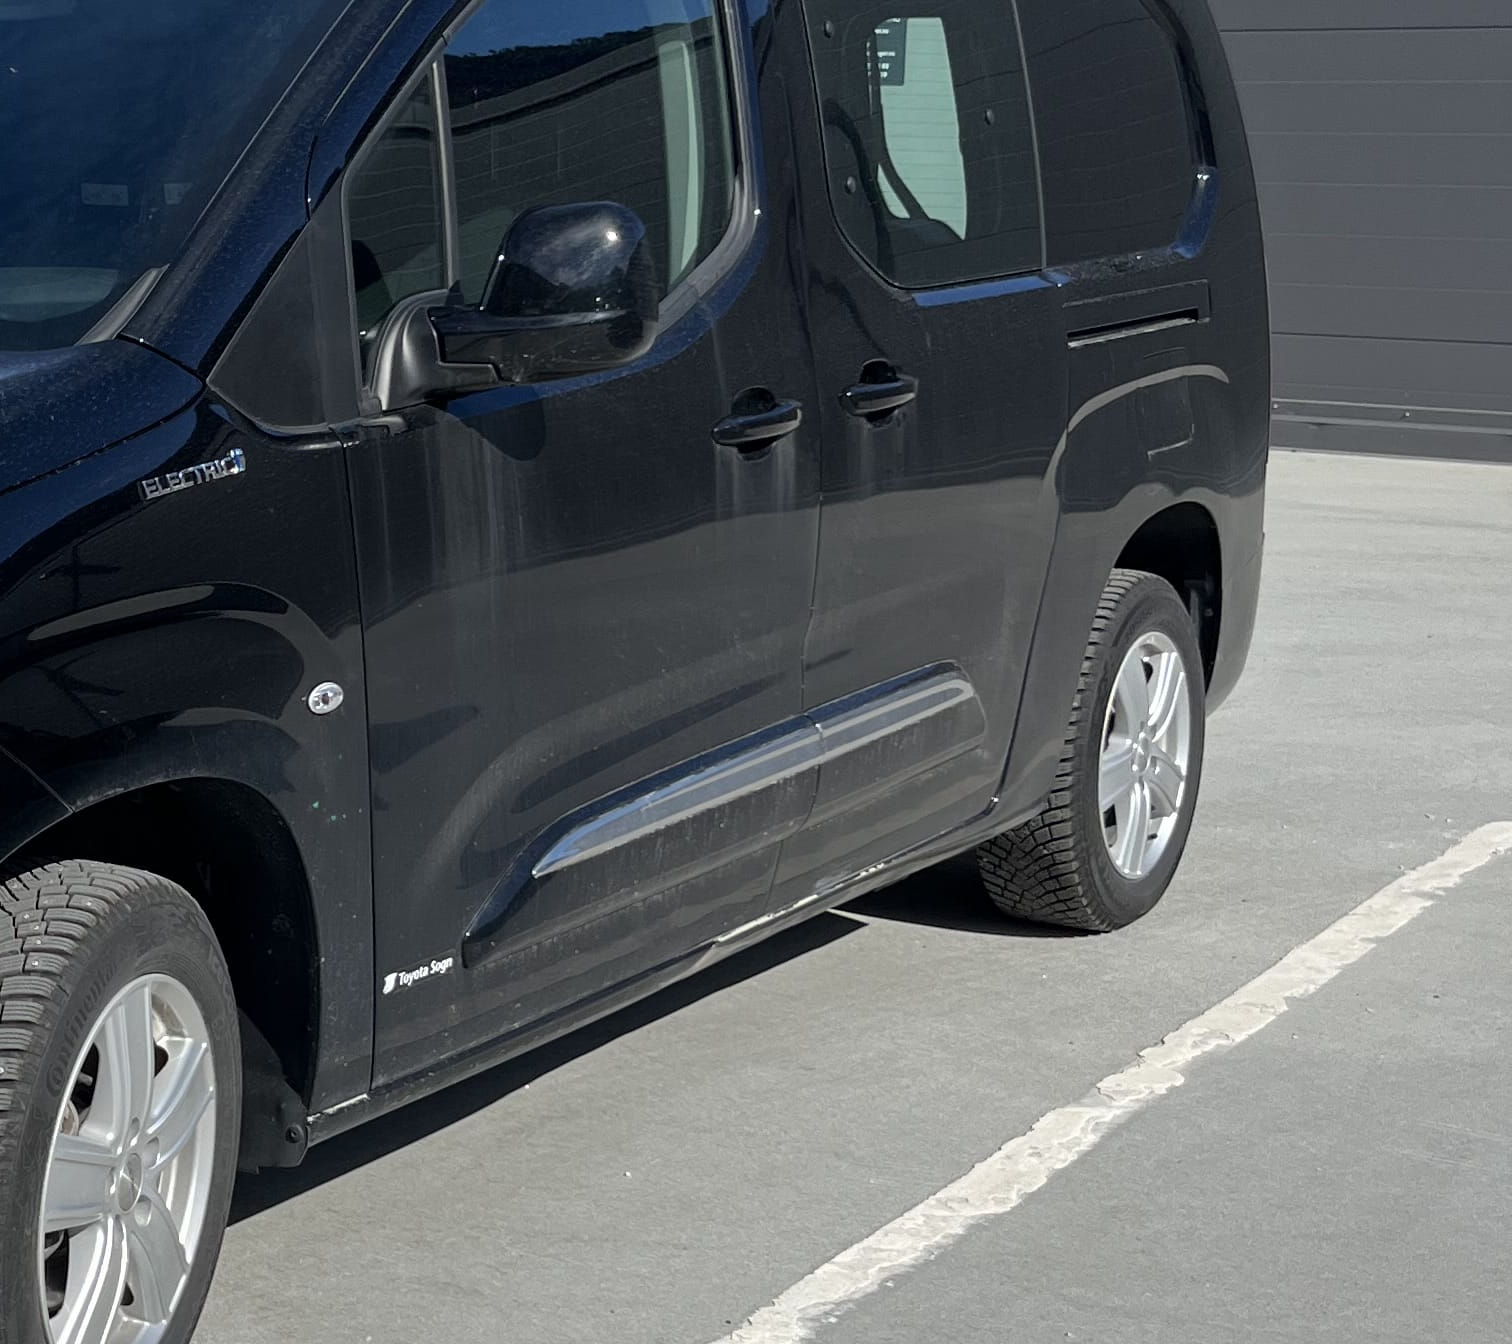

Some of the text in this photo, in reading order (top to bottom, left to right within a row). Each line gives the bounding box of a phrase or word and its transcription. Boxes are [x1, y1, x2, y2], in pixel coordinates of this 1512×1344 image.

[140, 456, 240, 500] ELECTRIC
[398, 957, 454, 986] Toyota Sogn
